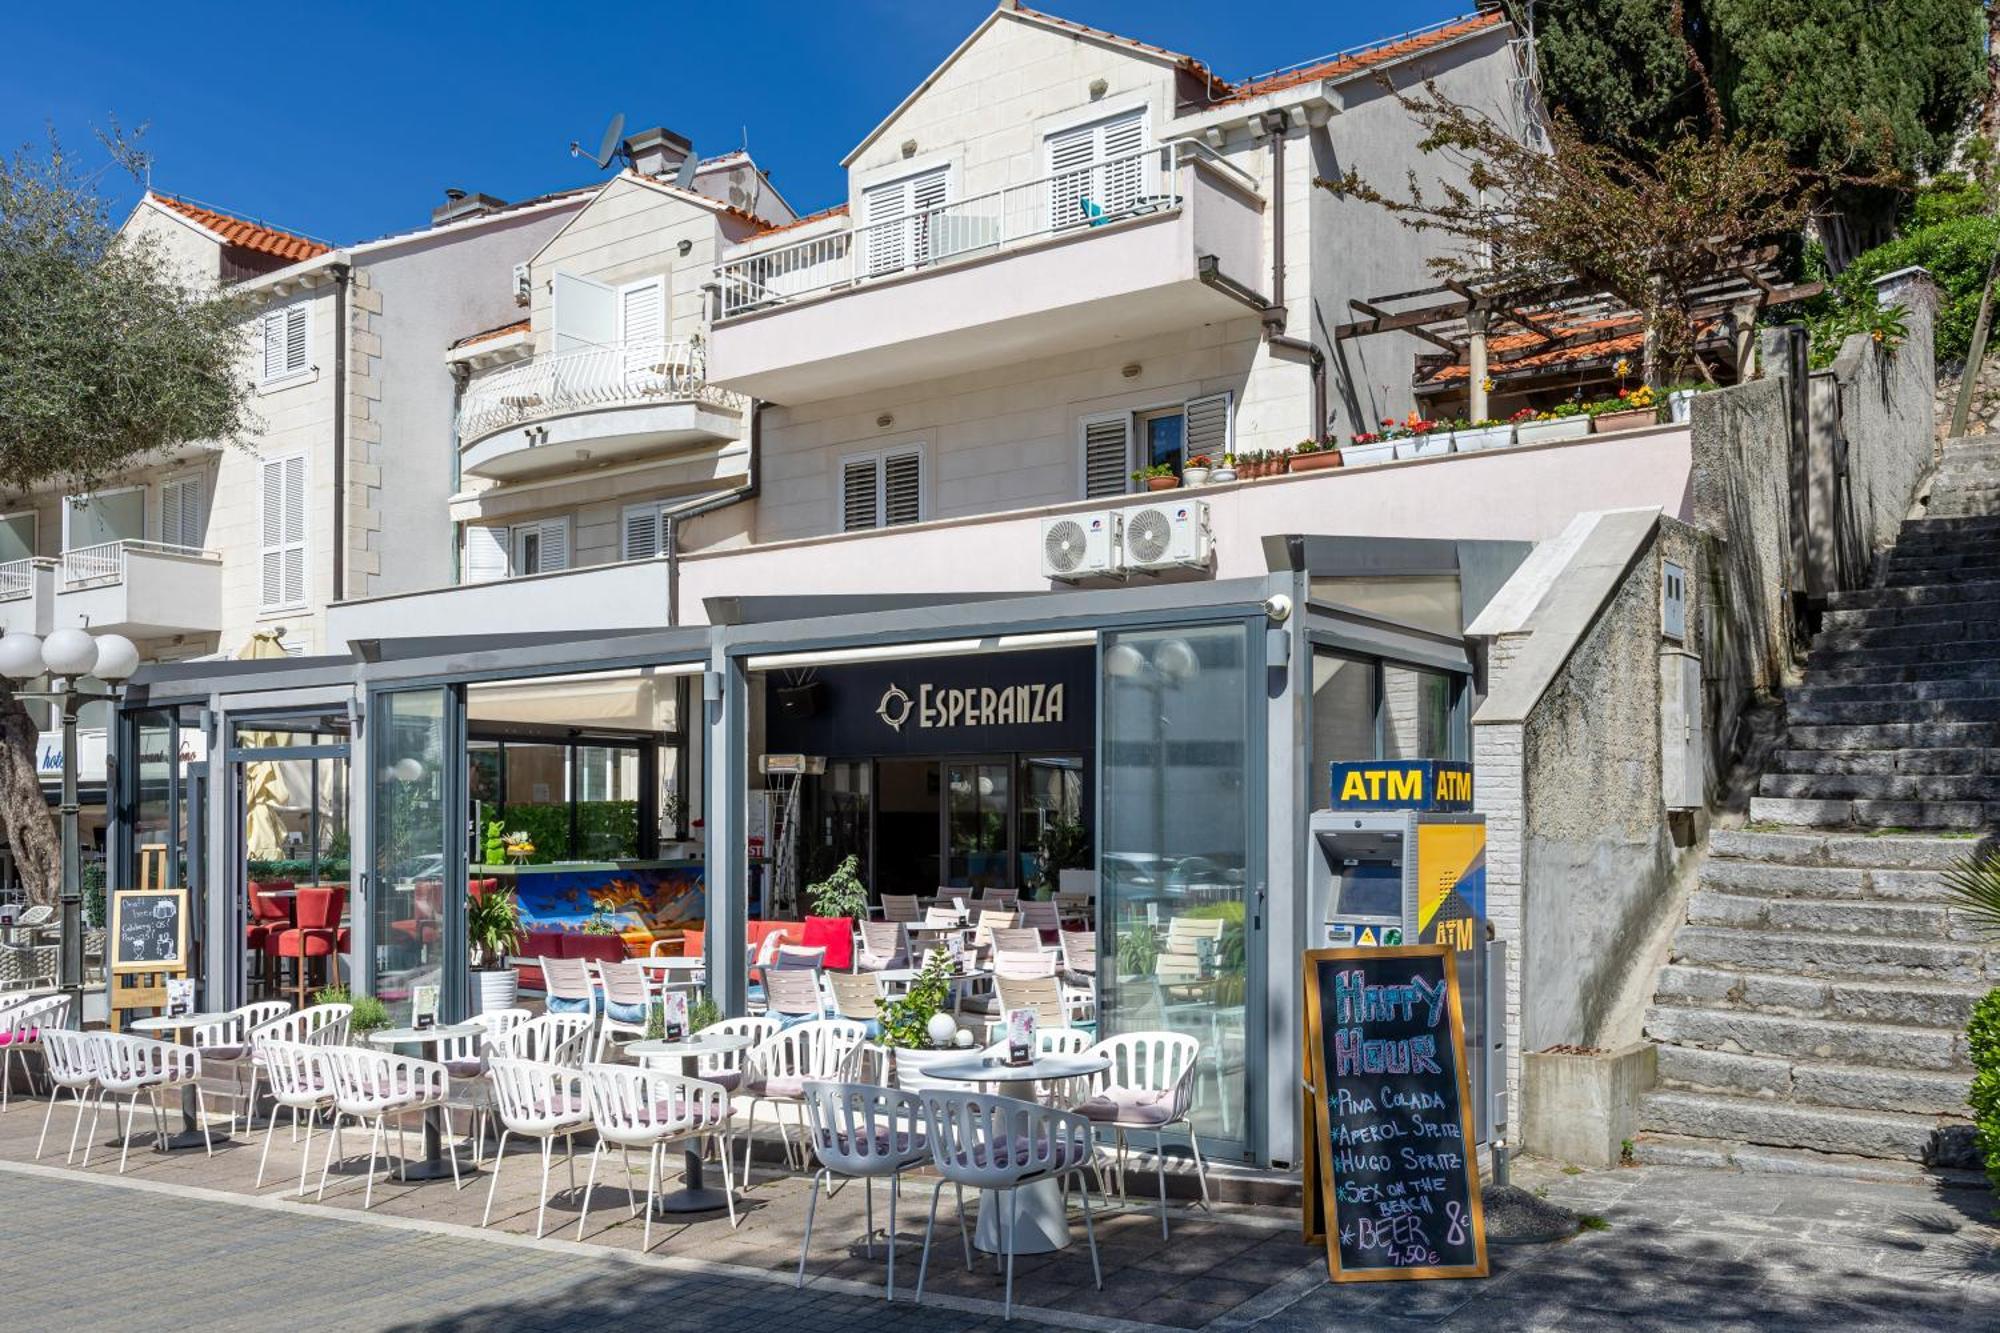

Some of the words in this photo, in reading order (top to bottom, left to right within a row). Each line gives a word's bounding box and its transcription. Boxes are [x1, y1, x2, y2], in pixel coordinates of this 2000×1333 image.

[919, 683, 1063, 728] ESPERANZA
[1341, 770, 1422, 800] ATM
[1436, 771, 1471, 801] ATM
[1436, 918, 1473, 951] ATM
[1335, 969, 1447, 1028] HAPPY
[1335, 1026, 1442, 1077] HOUR
[1340, 1122, 1408, 1146] APEROL
[1345, 1180, 1384, 1203] SEX
[1408, 1177, 1446, 1192] THE
[1377, 1195, 1433, 1217] BEACH
[1358, 1215, 1430, 1250] BEER
